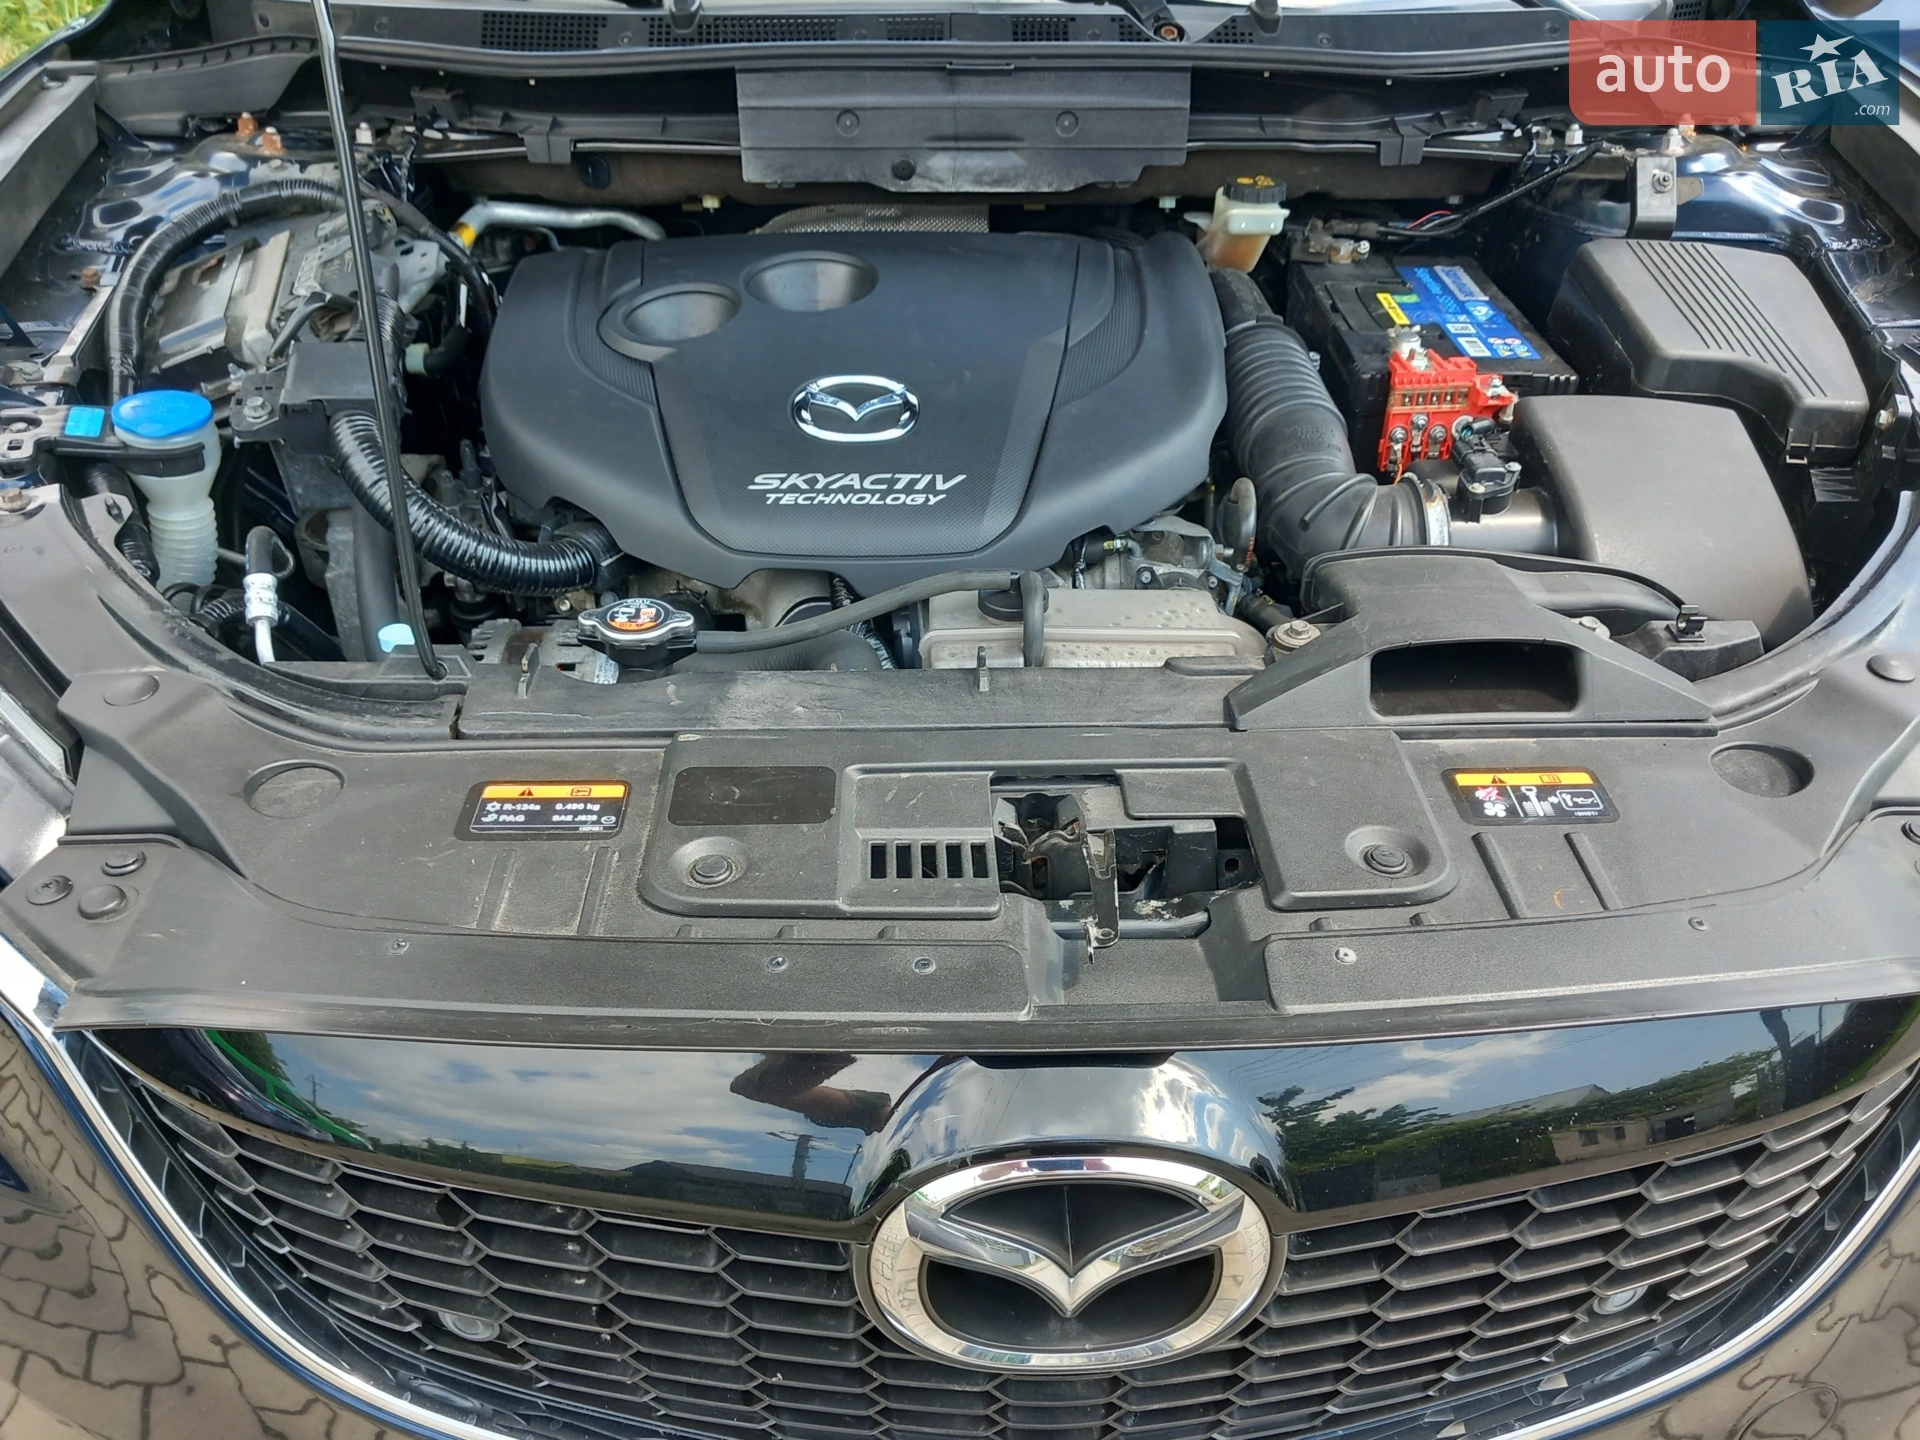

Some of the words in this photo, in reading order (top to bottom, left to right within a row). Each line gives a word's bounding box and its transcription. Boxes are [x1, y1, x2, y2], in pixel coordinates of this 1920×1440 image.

[747, 473, 967, 490] SKYACTIV
[765, 493, 947, 505] TECHNOLOGY
[502, 803, 541, 811] R-134a
[586, 803, 600, 812] kg
[499, 814, 526, 822] PAG
[552, 814, 573, 822] SAE
